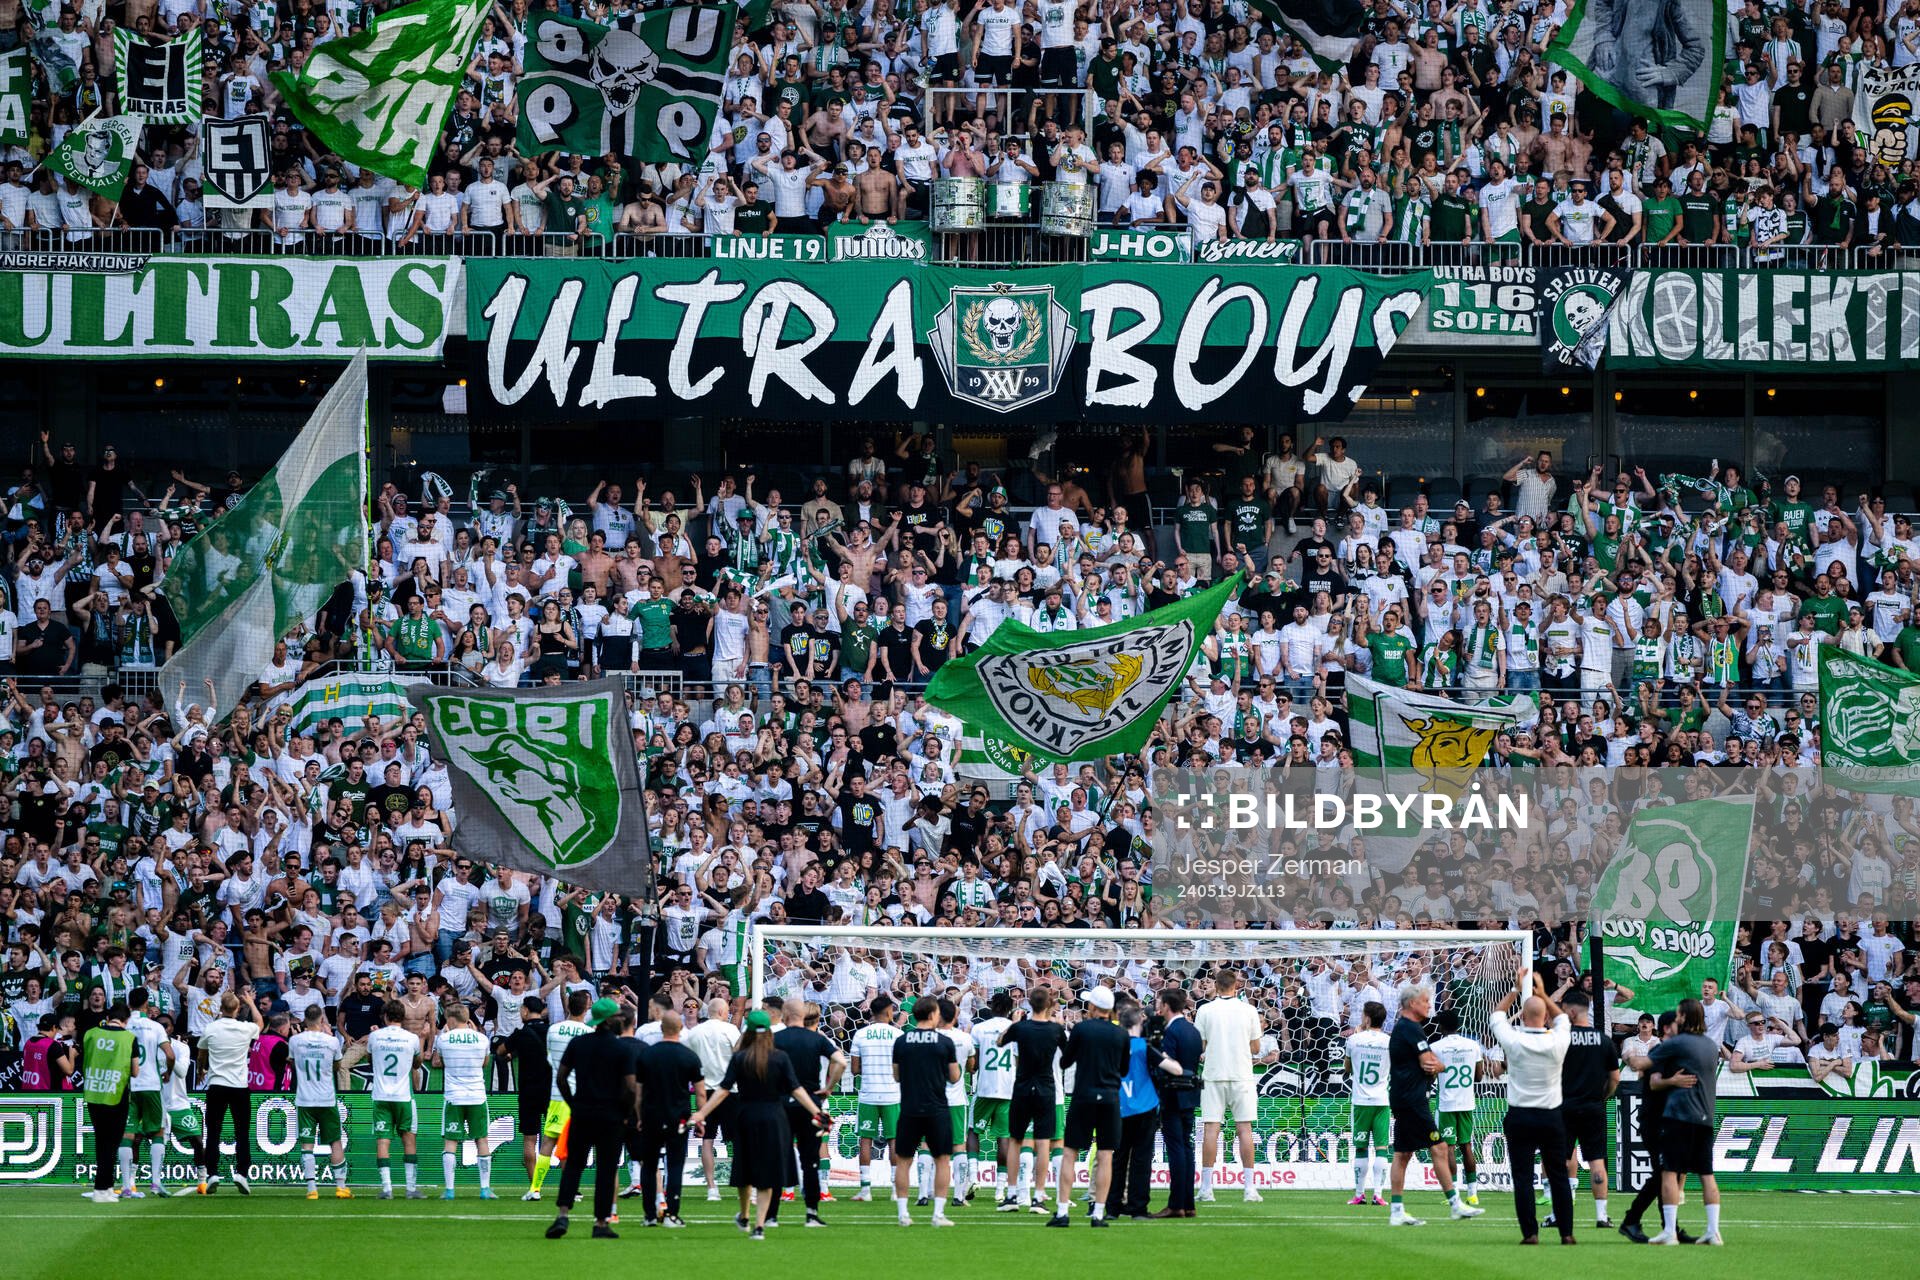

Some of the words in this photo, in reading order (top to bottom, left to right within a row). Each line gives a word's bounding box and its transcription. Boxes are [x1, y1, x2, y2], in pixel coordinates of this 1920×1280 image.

[127, 100, 187, 114] ULTRAS
[102, 120, 134, 146] BERGEN
[210, 123, 264, 171] E1
[715, 238, 784, 259] LINJE
[793, 238, 821, 260] 19
[834, 235, 926, 261] JUNIORS
[1433, 265, 1488, 281] ULTRA
[1489, 266, 1536, 284] BOYS
[0, 261, 447, 350] ULTRAS
[1434, 281, 1536, 312] 116
[1432, 309, 1534, 334] SOFIA
[482, 266, 925, 410] ULTRA
[969, 376, 981, 388] 19
[977, 367, 1028, 402] XXV
[1023, 376, 1040, 387] 99
[1783, 509, 1805, 520] BAJEN
[96, 1038, 115, 1051] 02
[448, 1033, 480, 1045] BAJEN
[866, 1028, 893, 1041] BAJEN
[906, 1031, 939, 1043] BAJEN
[1571, 1031, 1601, 1046] BAJEN
[305, 1059, 321, 1082] 11
[384, 1053, 399, 1077] 2
[985, 1047, 1012, 1072] 24
[22, 1070, 40, 1086] OTO
[247, 1072, 265, 1086] OTO
[1358, 1061, 1380, 1086] 15
[1444, 1064, 1472, 1089] 28
